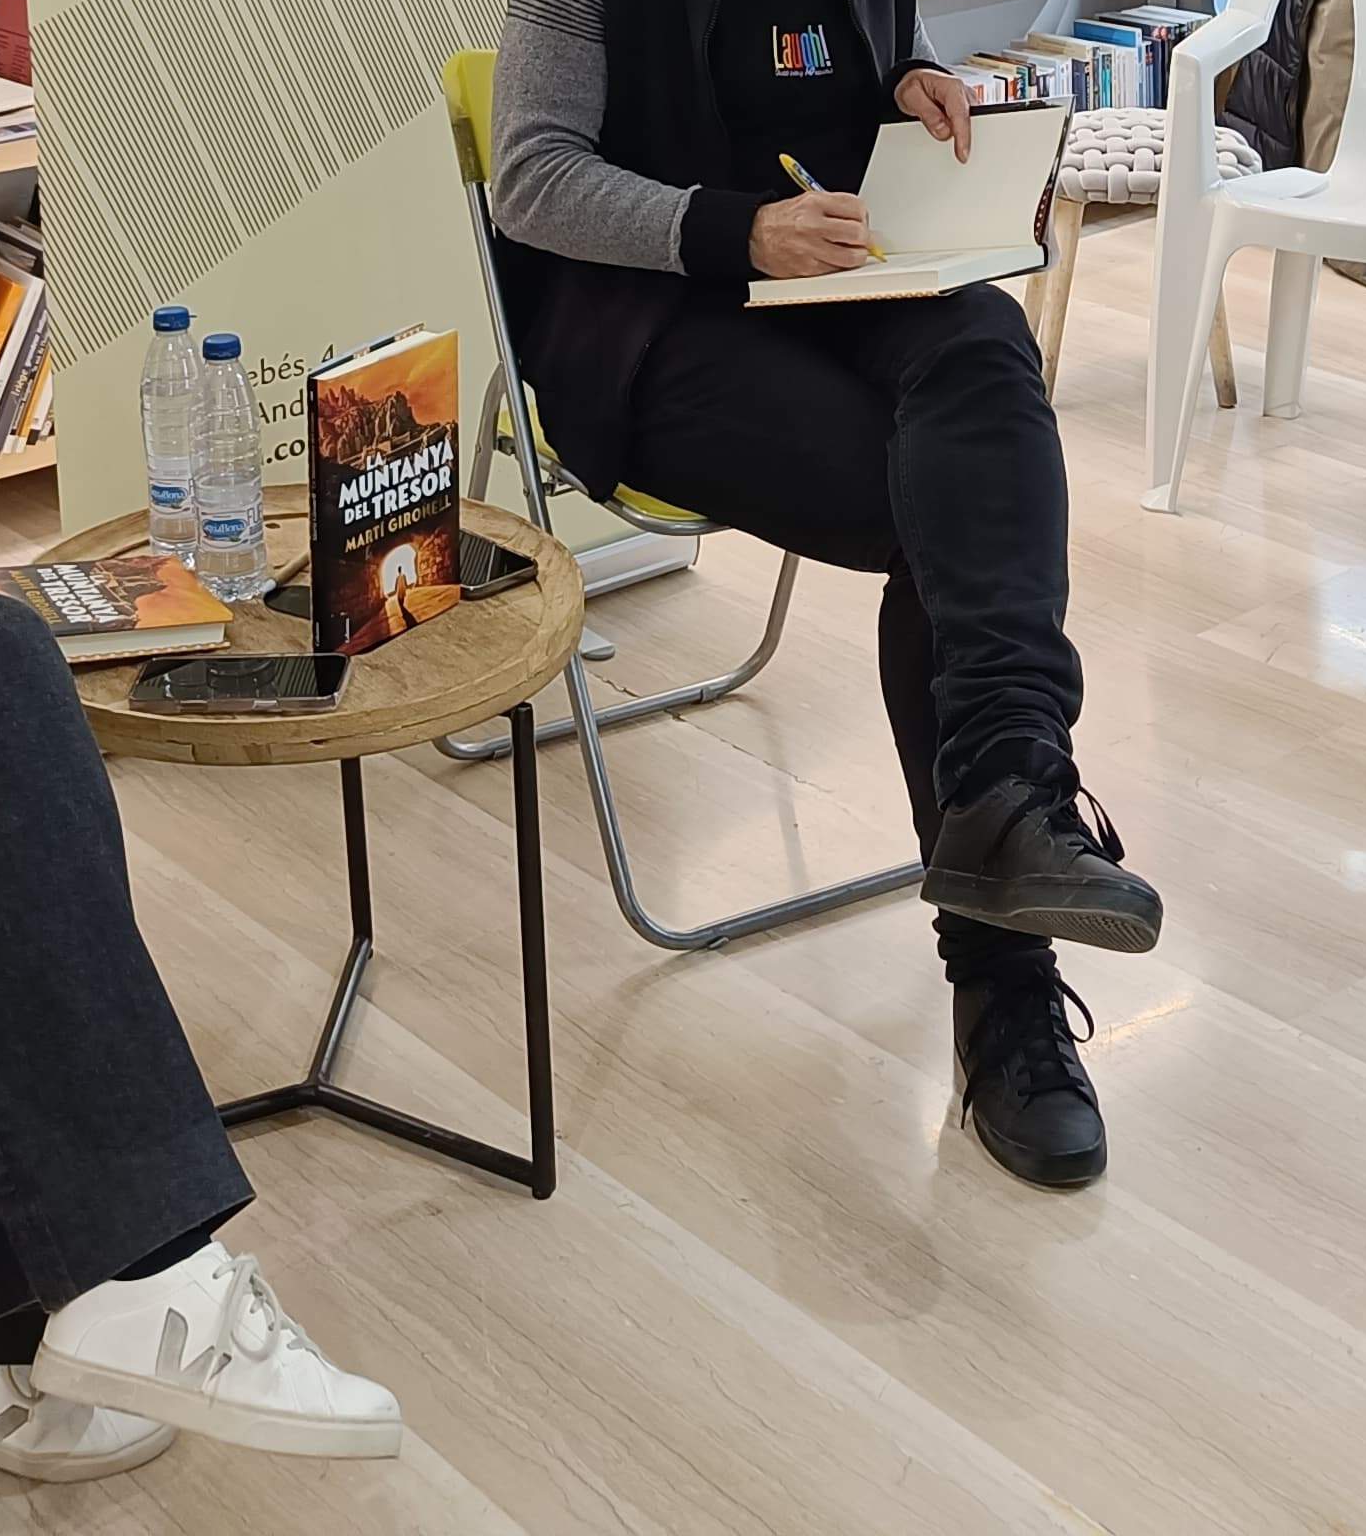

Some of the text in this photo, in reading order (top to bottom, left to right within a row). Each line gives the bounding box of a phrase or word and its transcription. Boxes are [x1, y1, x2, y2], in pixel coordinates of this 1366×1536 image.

[773, 24, 831, 68] Laugh!
[339, 440, 454, 509] MUNTANYA
[367, 455, 384, 470] LA
[344, 465, 452, 526] DEL TRESOR
[345, 498, 452, 553] MARTÍ GIRONELL
[36, 568, 93, 624] DEL TRESOR
[53, 564, 121, 624] MUNTANYA
